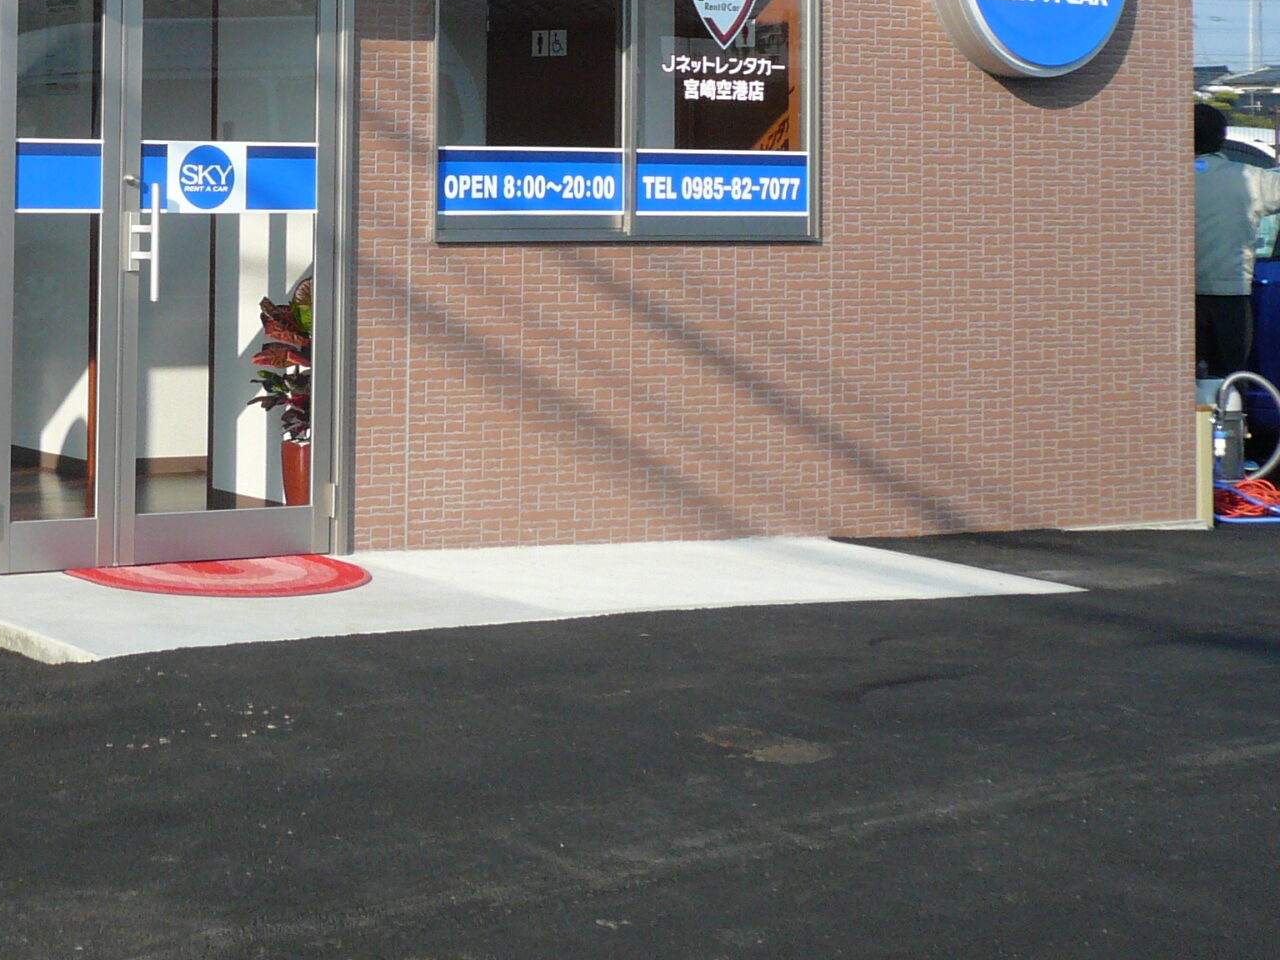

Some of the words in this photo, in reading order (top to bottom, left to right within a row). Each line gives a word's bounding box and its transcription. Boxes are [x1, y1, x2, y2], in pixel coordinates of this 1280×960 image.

[662, 55, 786, 76] Jネットレンタカー
[683, 78, 765, 102] 宮崎空港店
[180, 163, 233, 185] SKY
[443, 175, 498, 200] OPEN
[642, 176, 677, 200] TEL
[681, 176, 801, 201] 0985-82-7077
